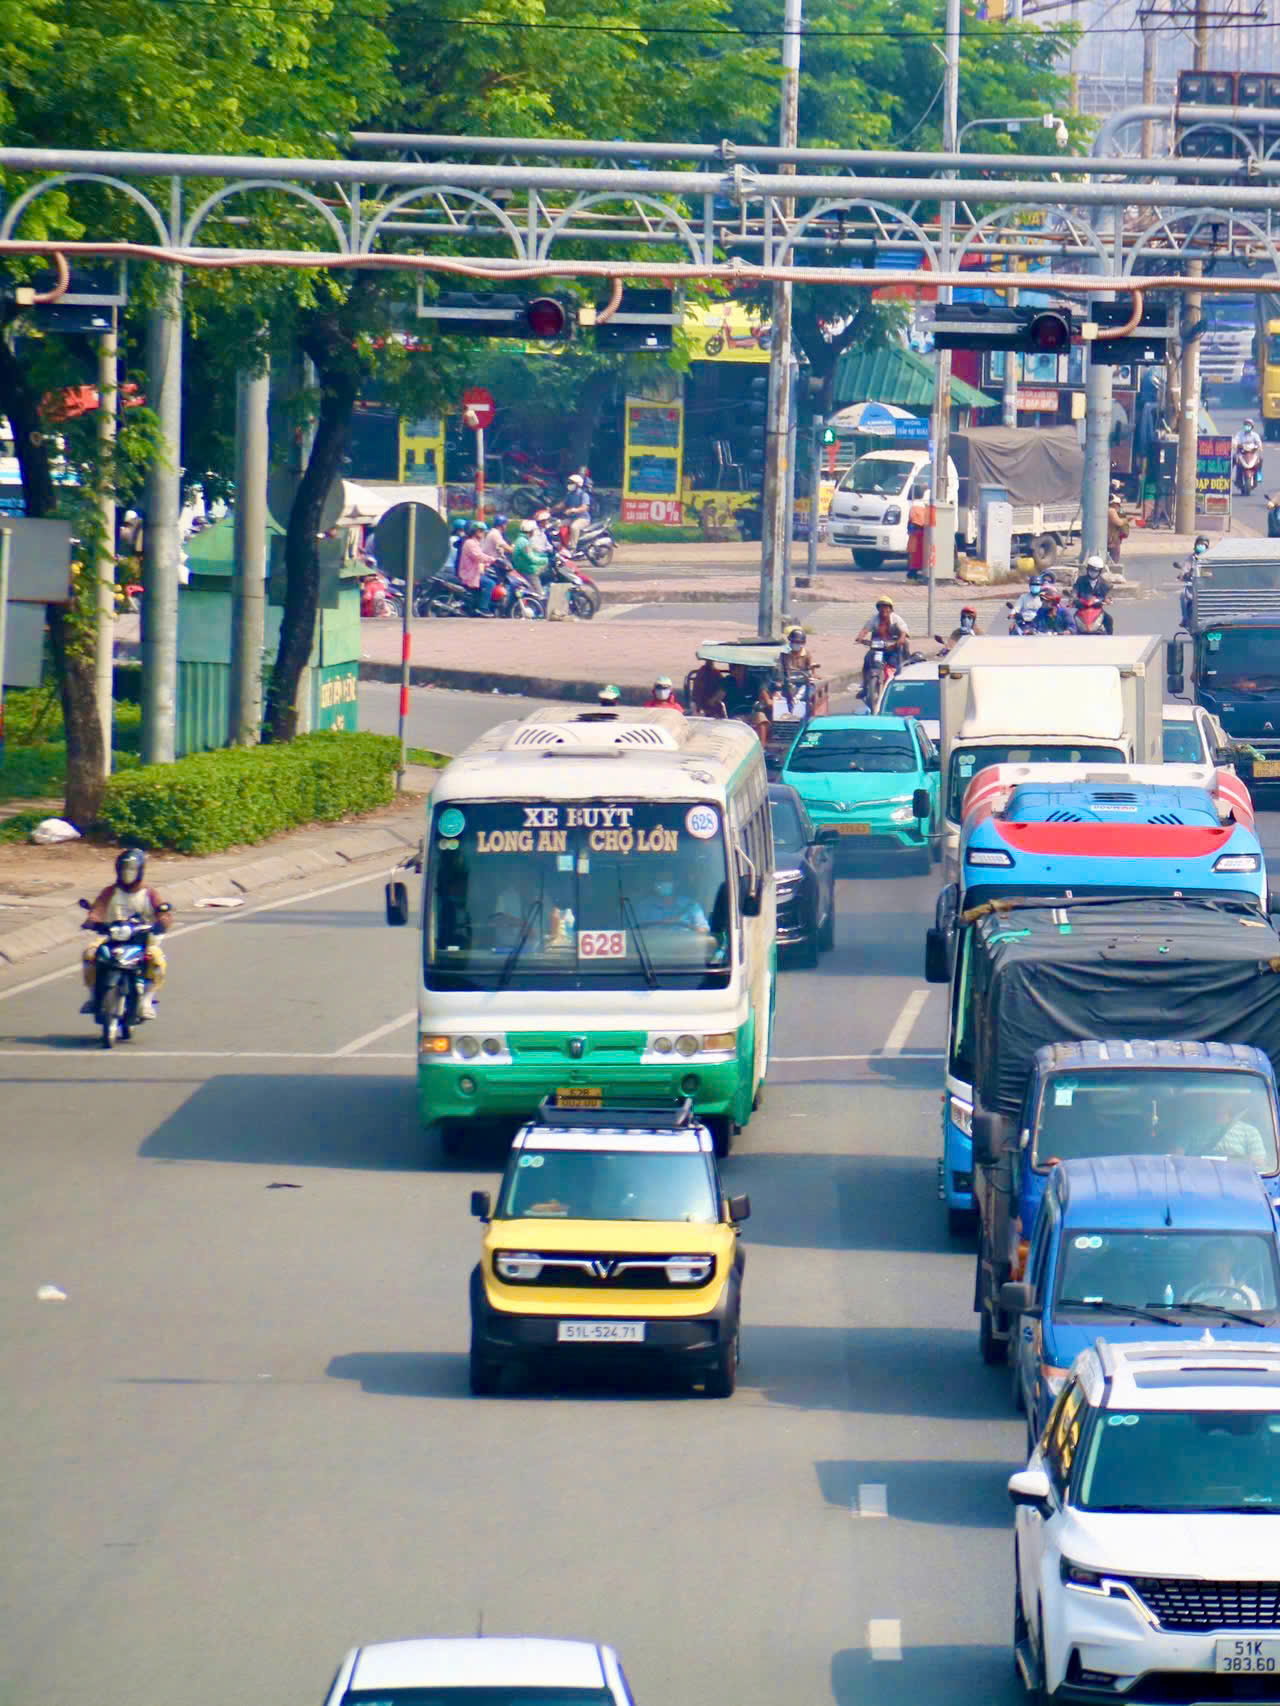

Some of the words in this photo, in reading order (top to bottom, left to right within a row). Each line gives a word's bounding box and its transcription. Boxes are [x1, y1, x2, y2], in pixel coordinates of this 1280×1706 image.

[650, 501, 680, 521] 0%
[523, 807, 558, 827] XE
[566, 803, 634, 828] BUÝT
[691, 813, 715, 832] 628
[476, 830, 533, 853] LONG
[537, 830, 567, 852] AN
[589, 826, 634, 856] CHỢ
[637, 824, 679, 852] LỚN
[581, 932, 624, 956] 628
[566, 1325, 637, 1338] 51L-524.71
[1235, 1641, 1263, 1656] 51K
[1223, 1657, 1276, 1672] 383.60
